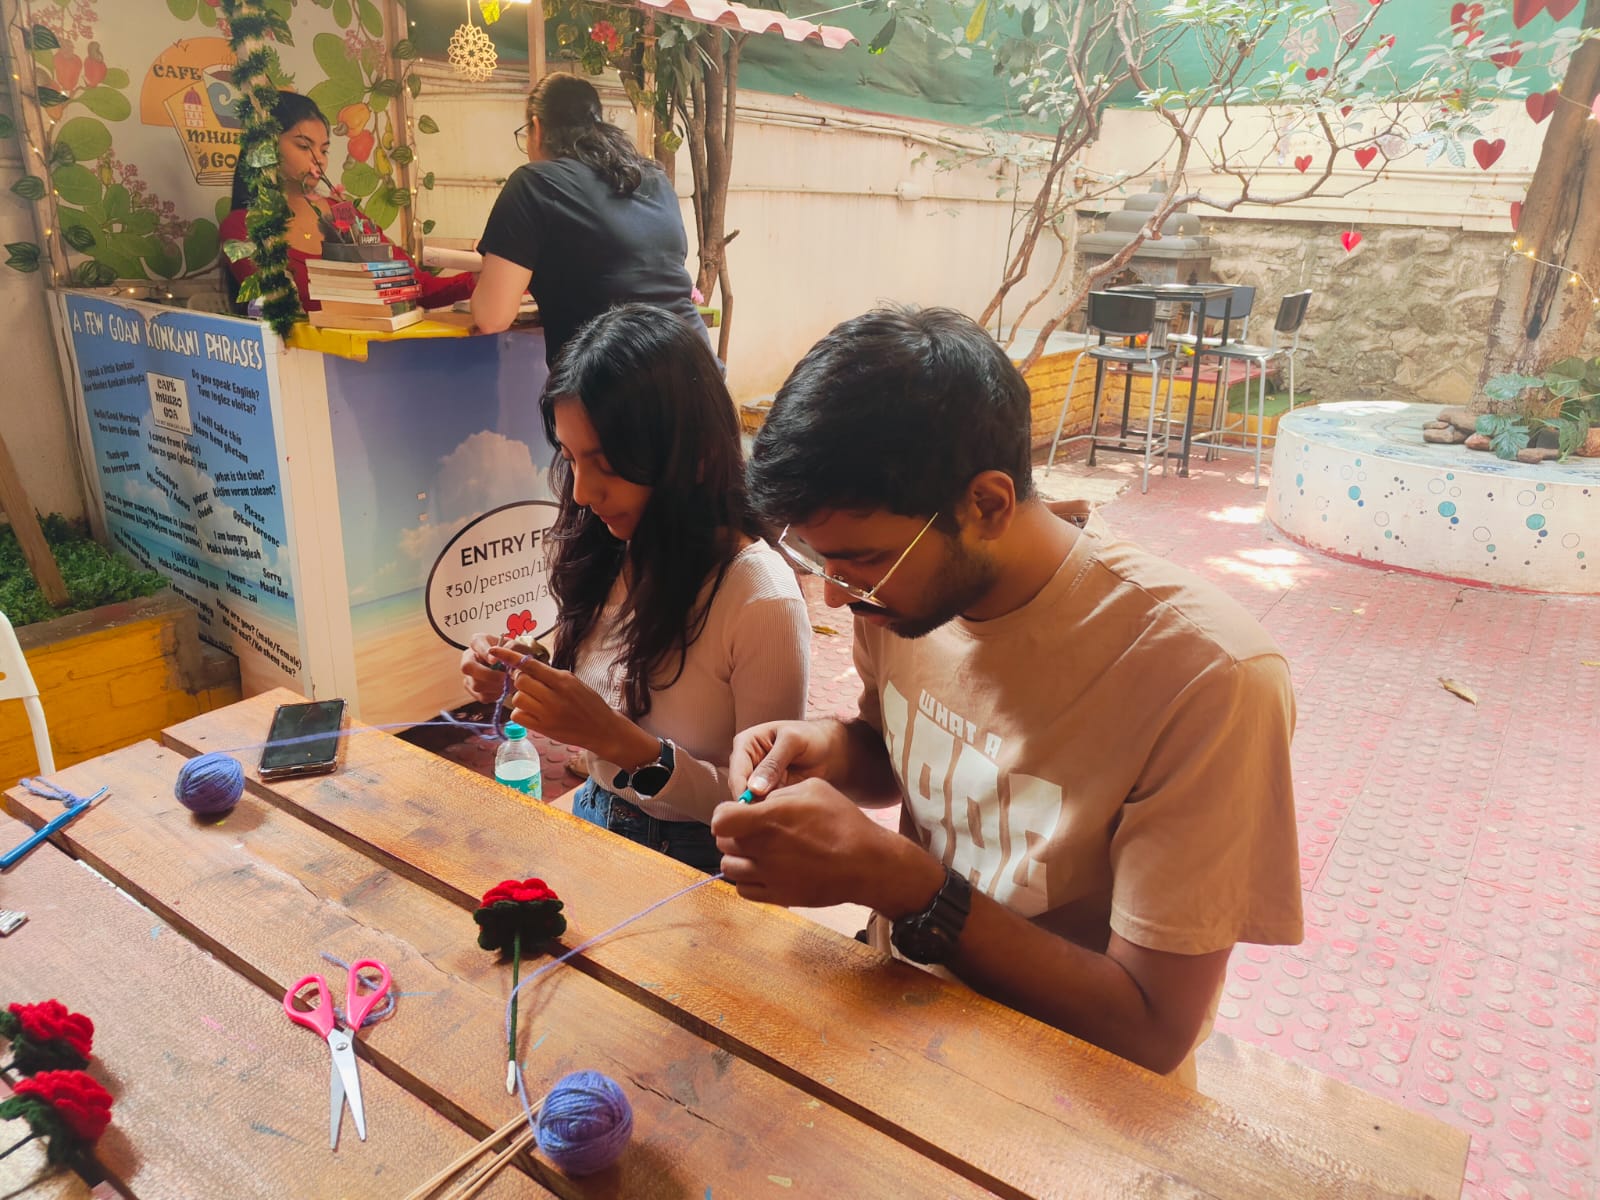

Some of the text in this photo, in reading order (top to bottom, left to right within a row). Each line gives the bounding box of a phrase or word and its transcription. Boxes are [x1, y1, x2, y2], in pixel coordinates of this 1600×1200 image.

[152, 64, 203, 81] CAFE
[211, 151, 238, 169] GO
[73, 310, 263, 370] A FEW GOAN KONKANI PHRASES
[201, 374, 212, 385] you
[212, 375, 231, 391] speak
[232, 382, 260, 401] English?
[163, 407, 179, 421] GOA
[167, 435, 181, 449] from
[214, 421, 228, 437] take
[229, 429, 242, 446] this
[214, 469, 265, 482] What is the time?
[244, 503, 265, 524] Please
[217, 532, 226, 540] am
[225, 530, 248, 546] hungry
[461, 533, 526, 568] ENTRY
[263, 567, 282, 586] Sorry
[445, 556, 551, 598] ₹50/person/1
[216, 598, 230, 614] How
[230, 608, 241, 621] are
[240, 618, 255, 634] you?
[443, 583, 550, 628] ₹100/person/3
[918, 688, 1002, 759] WHAT A
